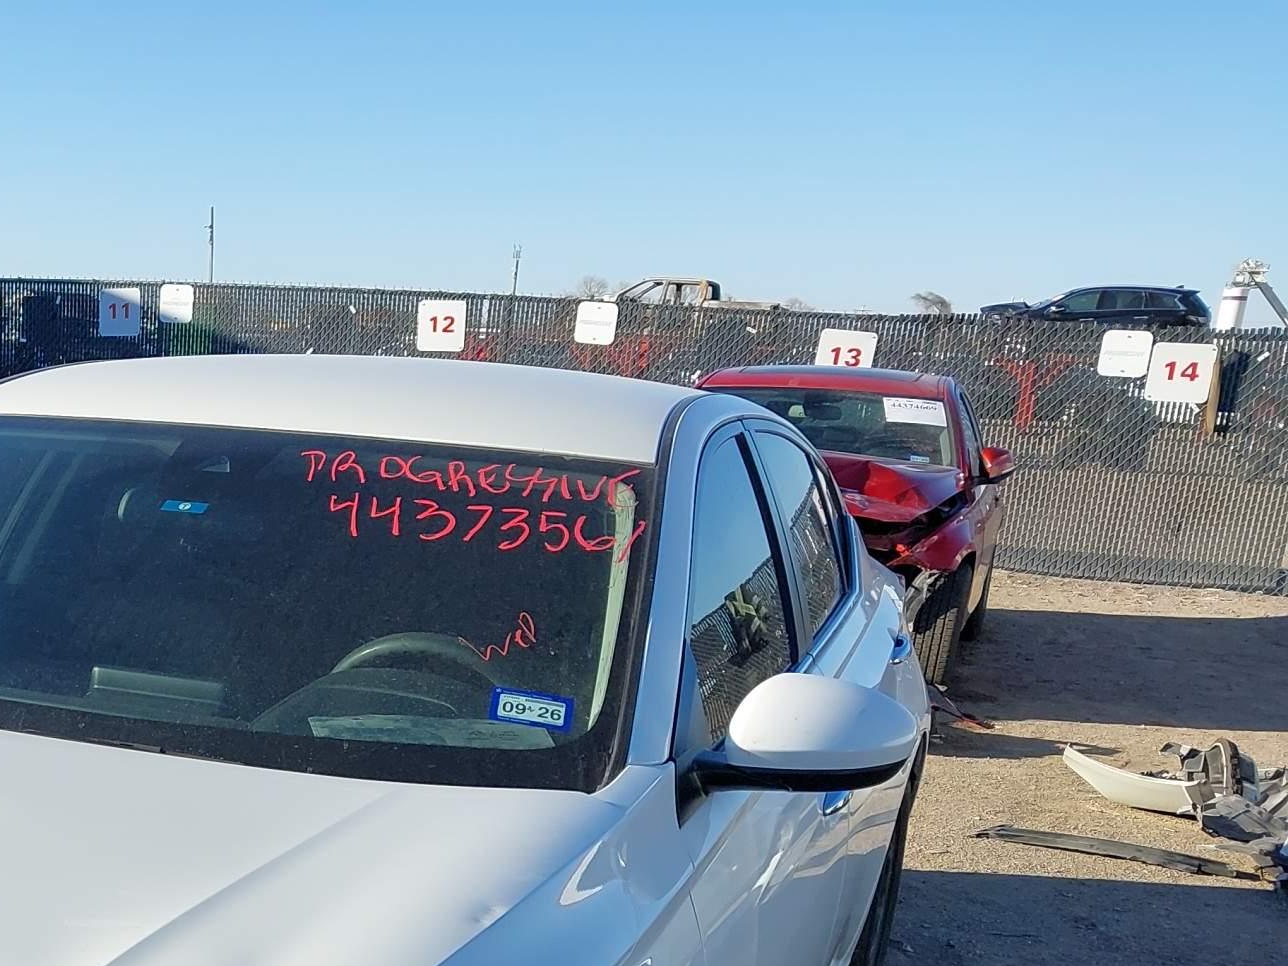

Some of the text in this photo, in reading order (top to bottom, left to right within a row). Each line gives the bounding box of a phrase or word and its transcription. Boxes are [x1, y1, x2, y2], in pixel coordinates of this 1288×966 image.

[107, 301, 132, 321] 11
[428, 314, 456, 334] 12
[829, 346, 864, 368] 13
[1164, 360, 1200, 382] 14
[502, 700, 527, 715] 09
[537, 706, 563, 721] 26
